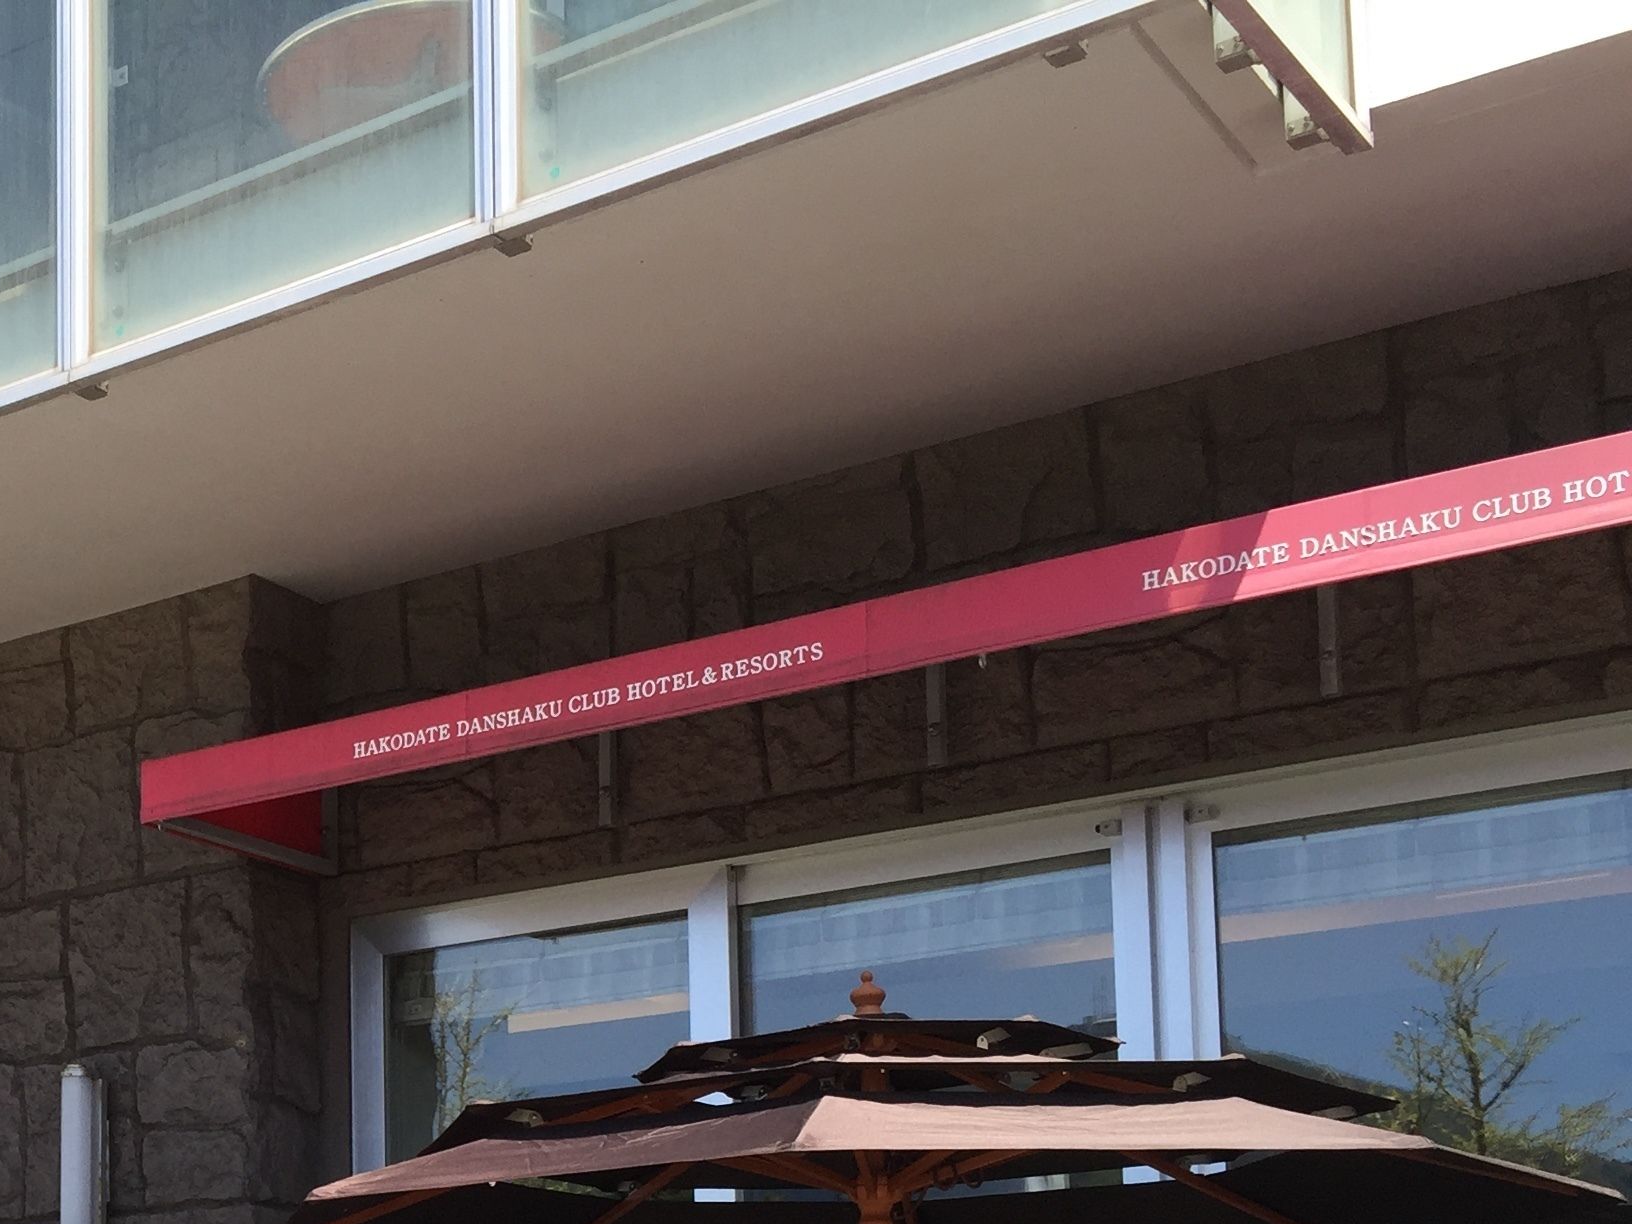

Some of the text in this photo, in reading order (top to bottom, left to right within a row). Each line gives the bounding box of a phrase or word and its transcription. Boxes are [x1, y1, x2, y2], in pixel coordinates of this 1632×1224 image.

[1141, 541, 1290, 592] HAKODATE
[1299, 506, 1463, 559] DANSHAKU
[1471, 486, 1553, 523] CLUB
[352, 723, 451, 760] HAKODATE
[456, 699, 564, 738] DANSHAKU
[567, 685, 621, 715] CLUB
